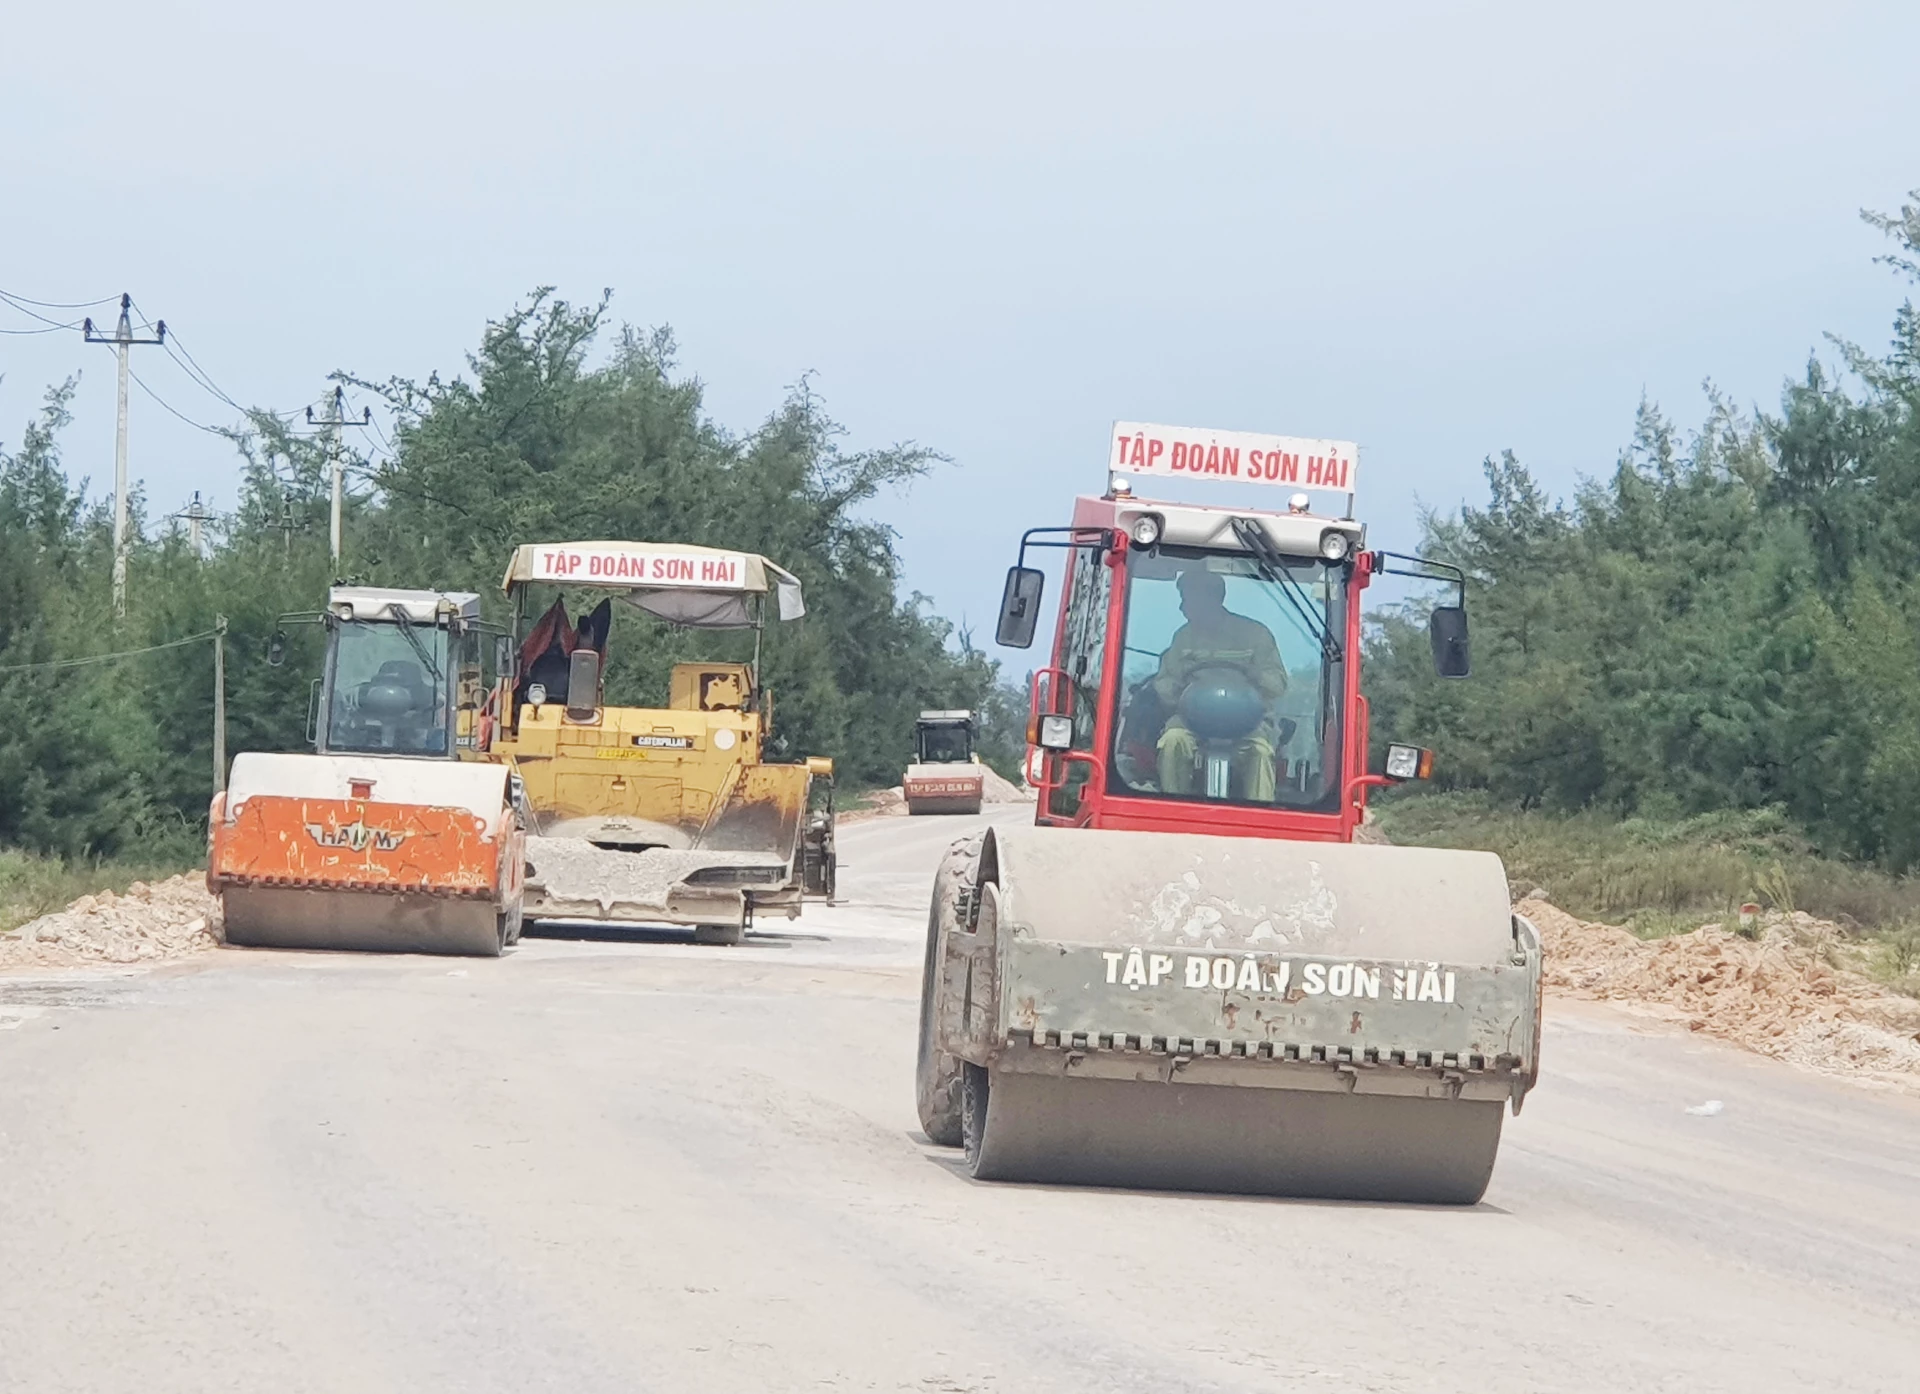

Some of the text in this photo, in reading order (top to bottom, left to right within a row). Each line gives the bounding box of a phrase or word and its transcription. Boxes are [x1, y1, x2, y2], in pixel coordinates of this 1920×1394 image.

[1117, 431, 1349, 488] TẬP ĐOÀN SƠN HẢI
[543, 551, 736, 582] TẬP ĐOÀN SƠN HẢI
[1102, 946, 1174, 990] TẬP
[1301, 962, 1382, 1000] SƠN
[1393, 961, 1456, 1003] HẢI
